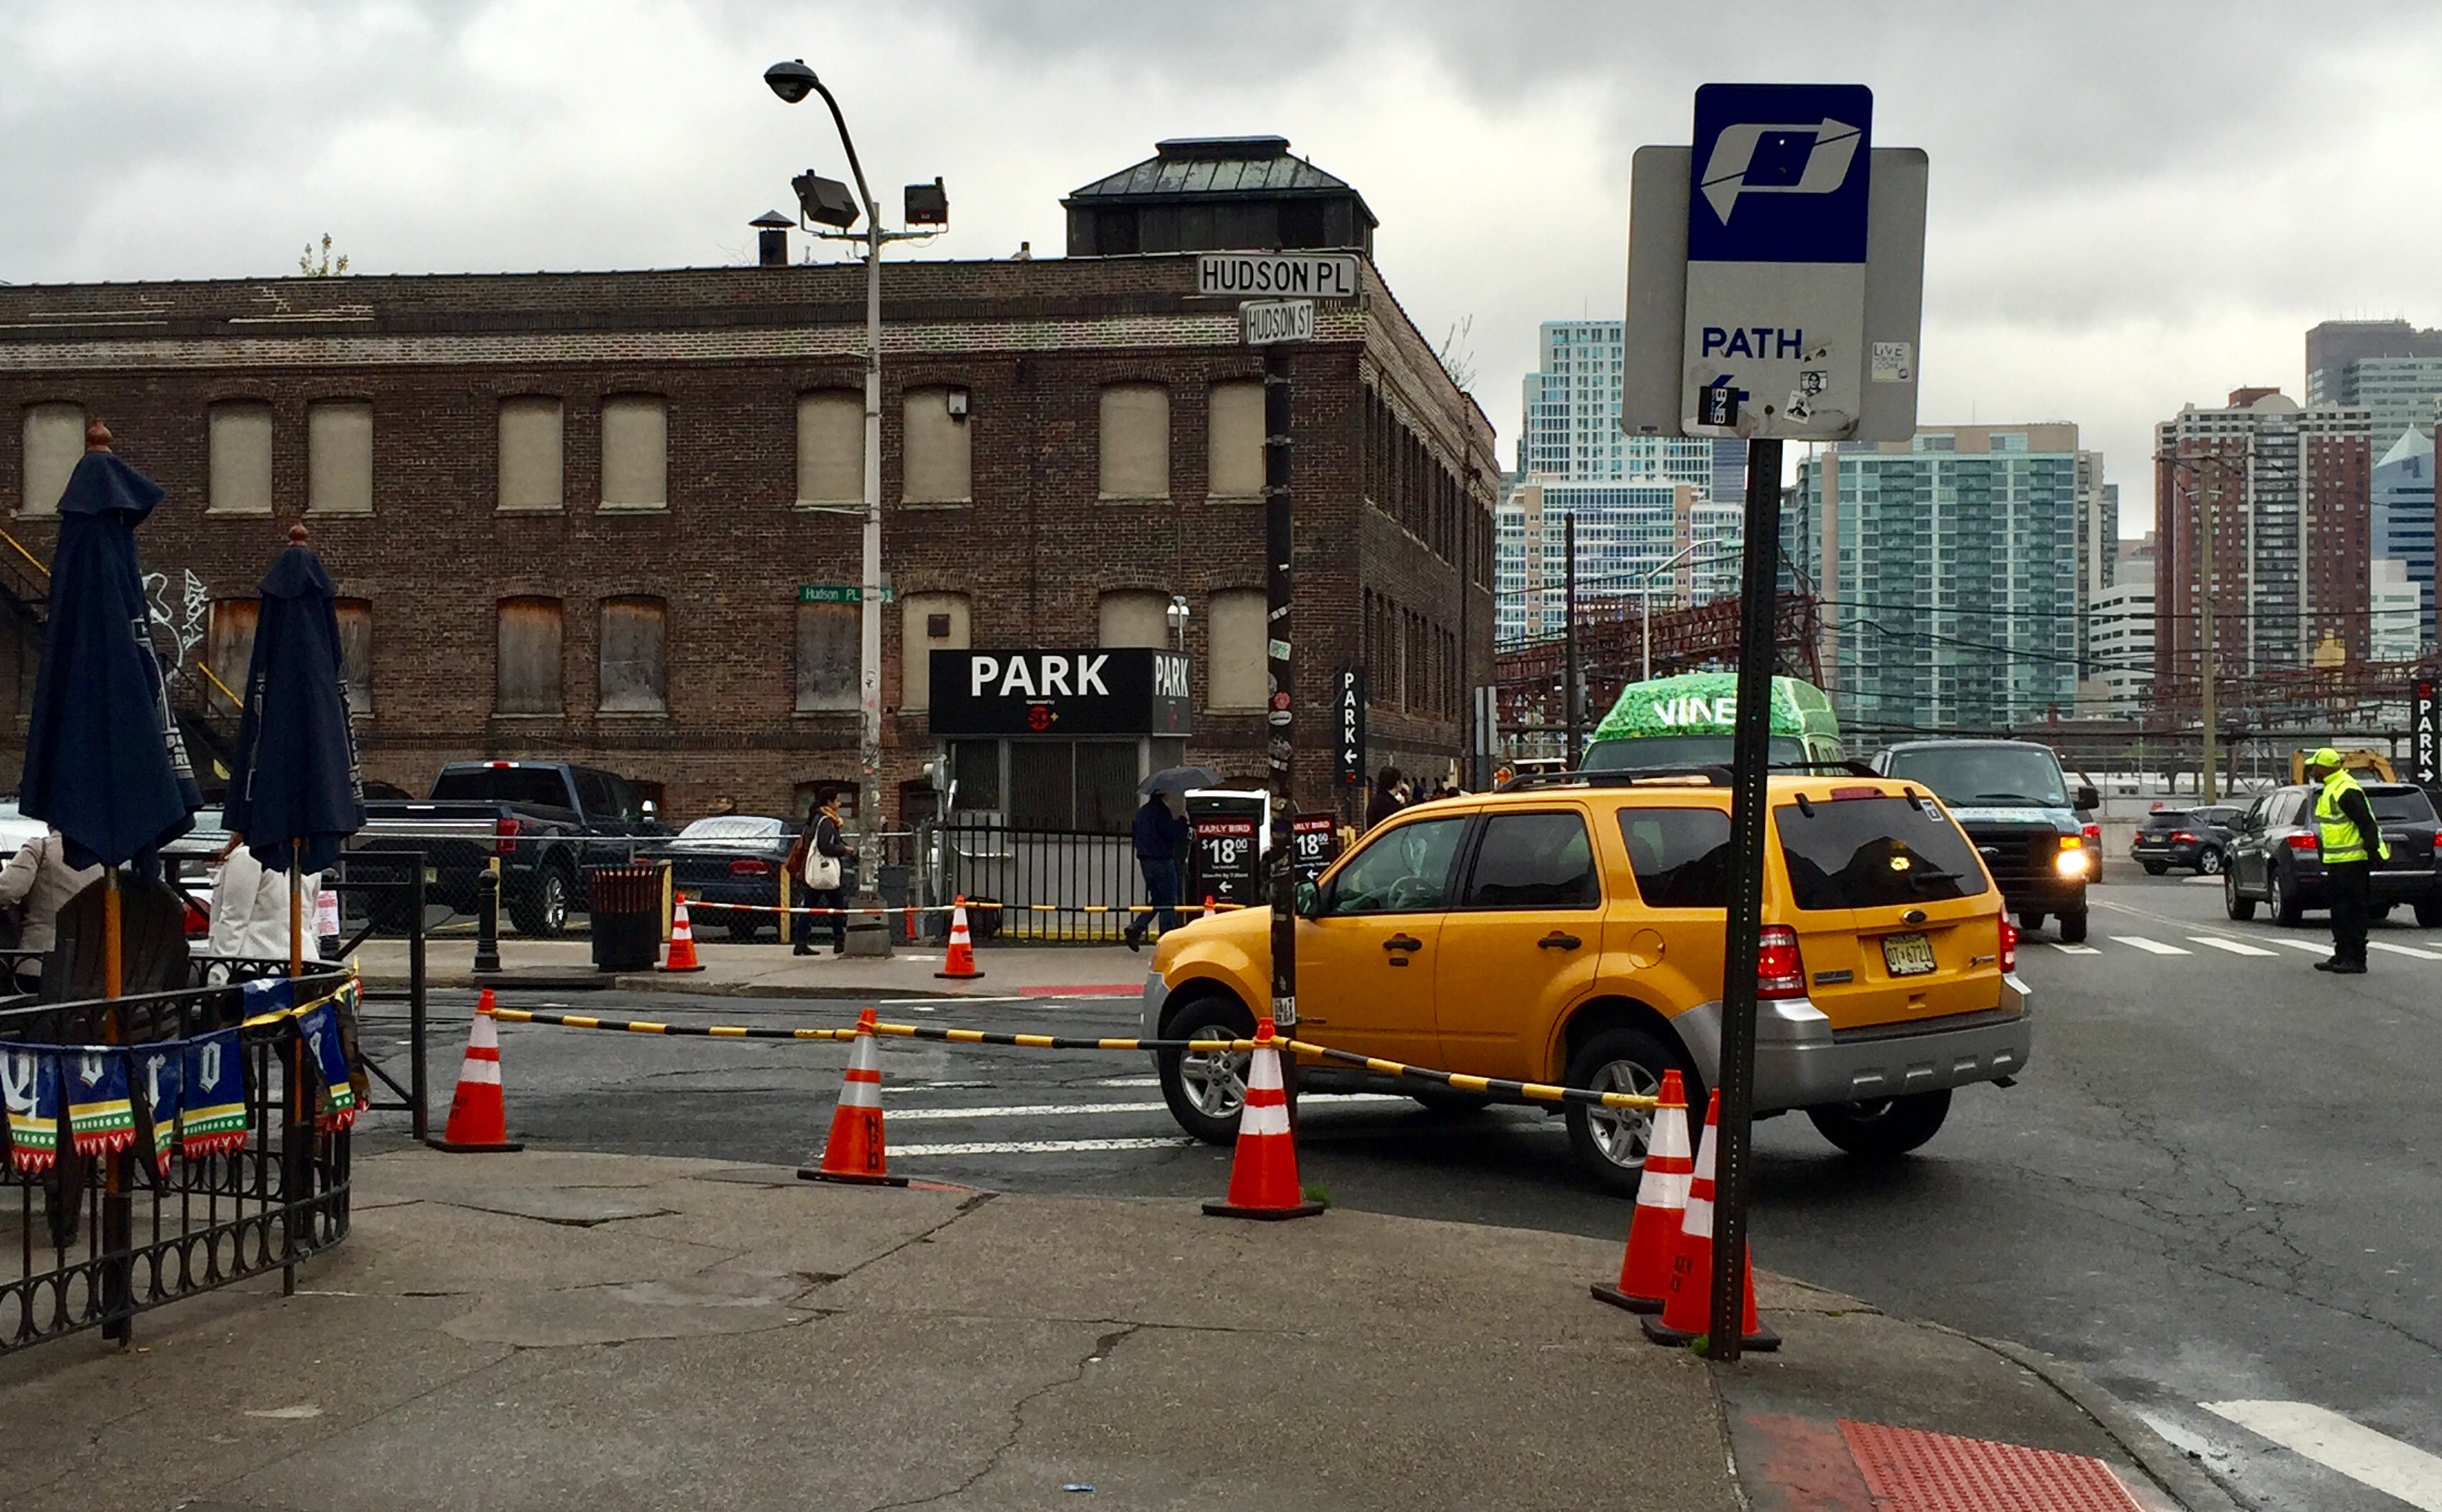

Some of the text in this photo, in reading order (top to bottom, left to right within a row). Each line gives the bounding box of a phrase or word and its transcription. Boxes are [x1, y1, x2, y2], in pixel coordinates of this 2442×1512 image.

[1203, 260, 1350, 293] HUDSON PL
[1248, 305, 1312, 341] HUDSON ST
[1702, 327, 1802, 358] PATH
[805, 587, 839, 600] Hudson
[971, 655, 1110, 697] PARK
[1155, 655, 1189, 698] PARK
[1344, 672, 1356, 744] PARK
[1653, 698, 1737, 726] VINE
[2417, 699, 2434, 766] PARK
[1199, 824, 1250, 834] EARLY BIRD
